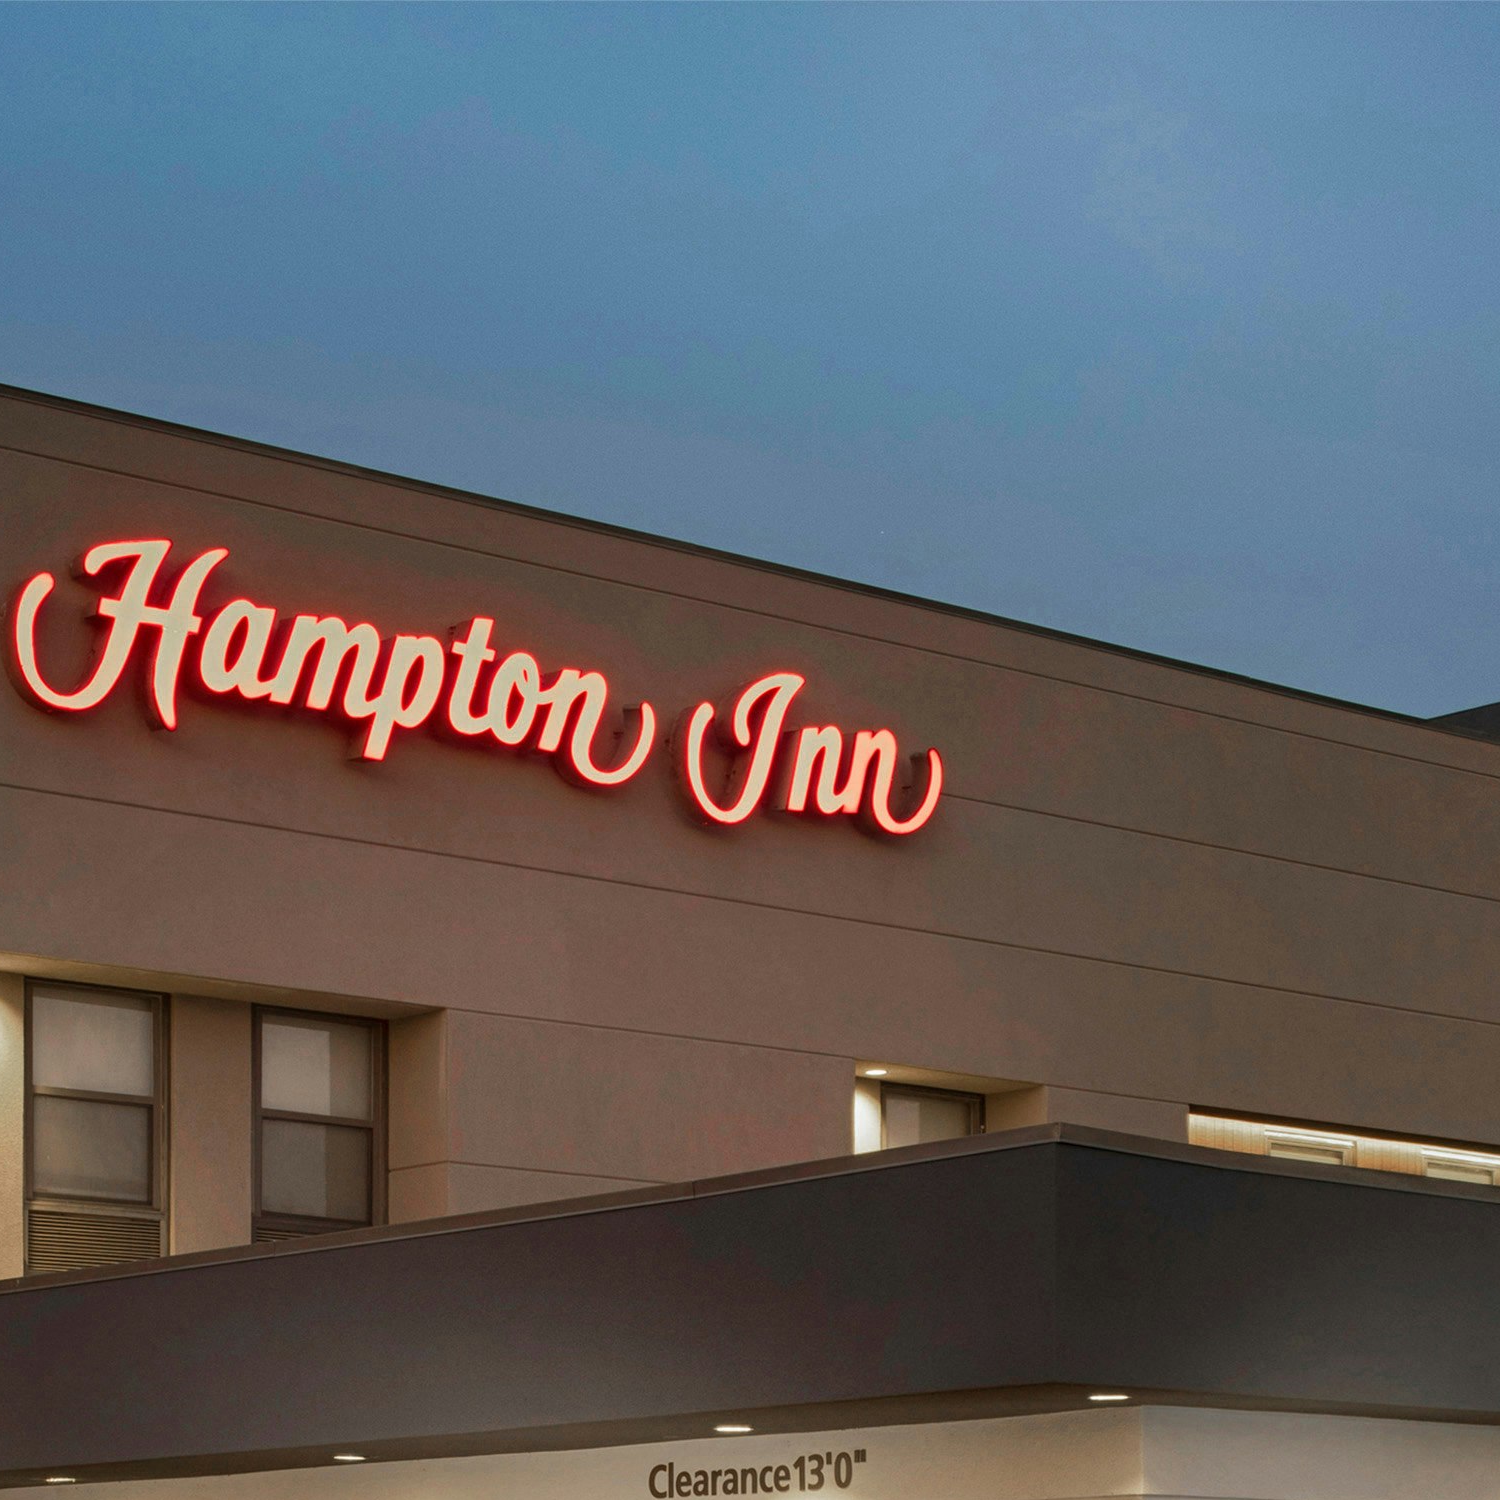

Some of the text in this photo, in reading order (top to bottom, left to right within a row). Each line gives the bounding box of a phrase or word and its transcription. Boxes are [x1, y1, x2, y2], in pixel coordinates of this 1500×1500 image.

[12, 538, 943, 836] Hampton Inn
[648, 1448, 868, 1499] Clearance 13'0"
